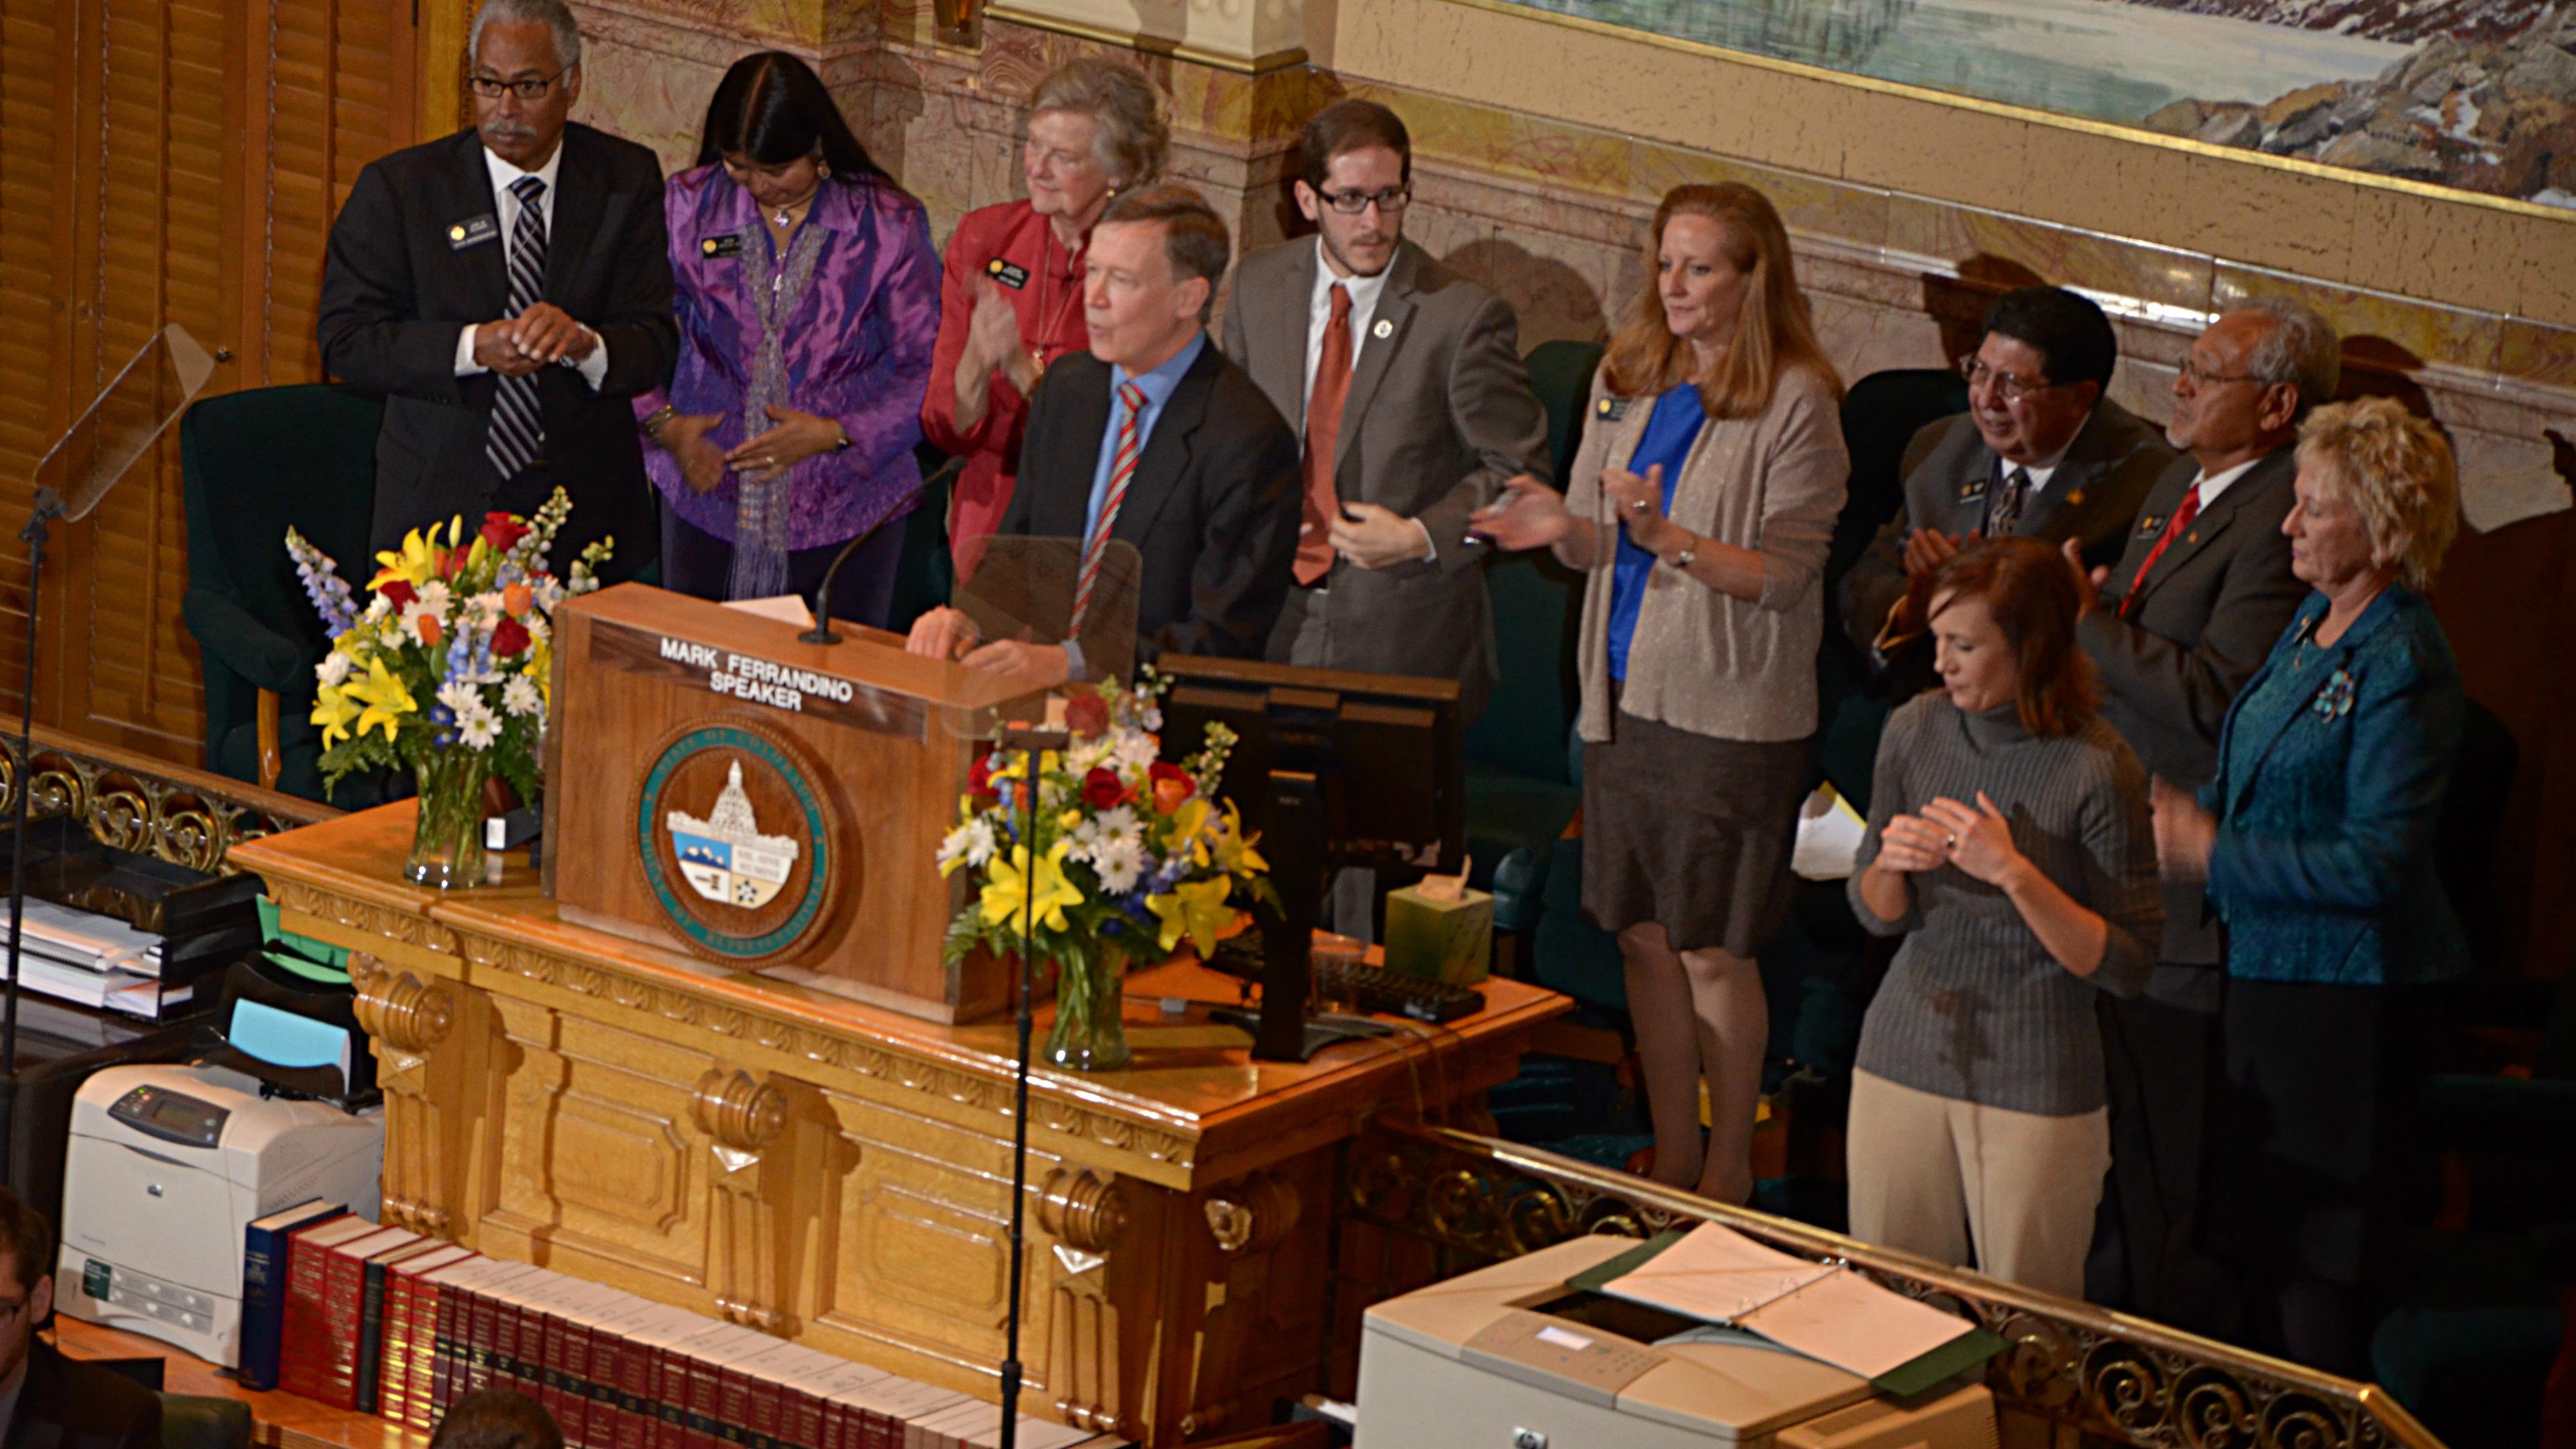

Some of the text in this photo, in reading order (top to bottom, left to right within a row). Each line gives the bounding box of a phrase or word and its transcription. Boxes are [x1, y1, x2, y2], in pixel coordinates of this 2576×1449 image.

[661, 638, 852, 702] MARK FERRANDINO
[710, 671, 801, 711] SPEAKER
